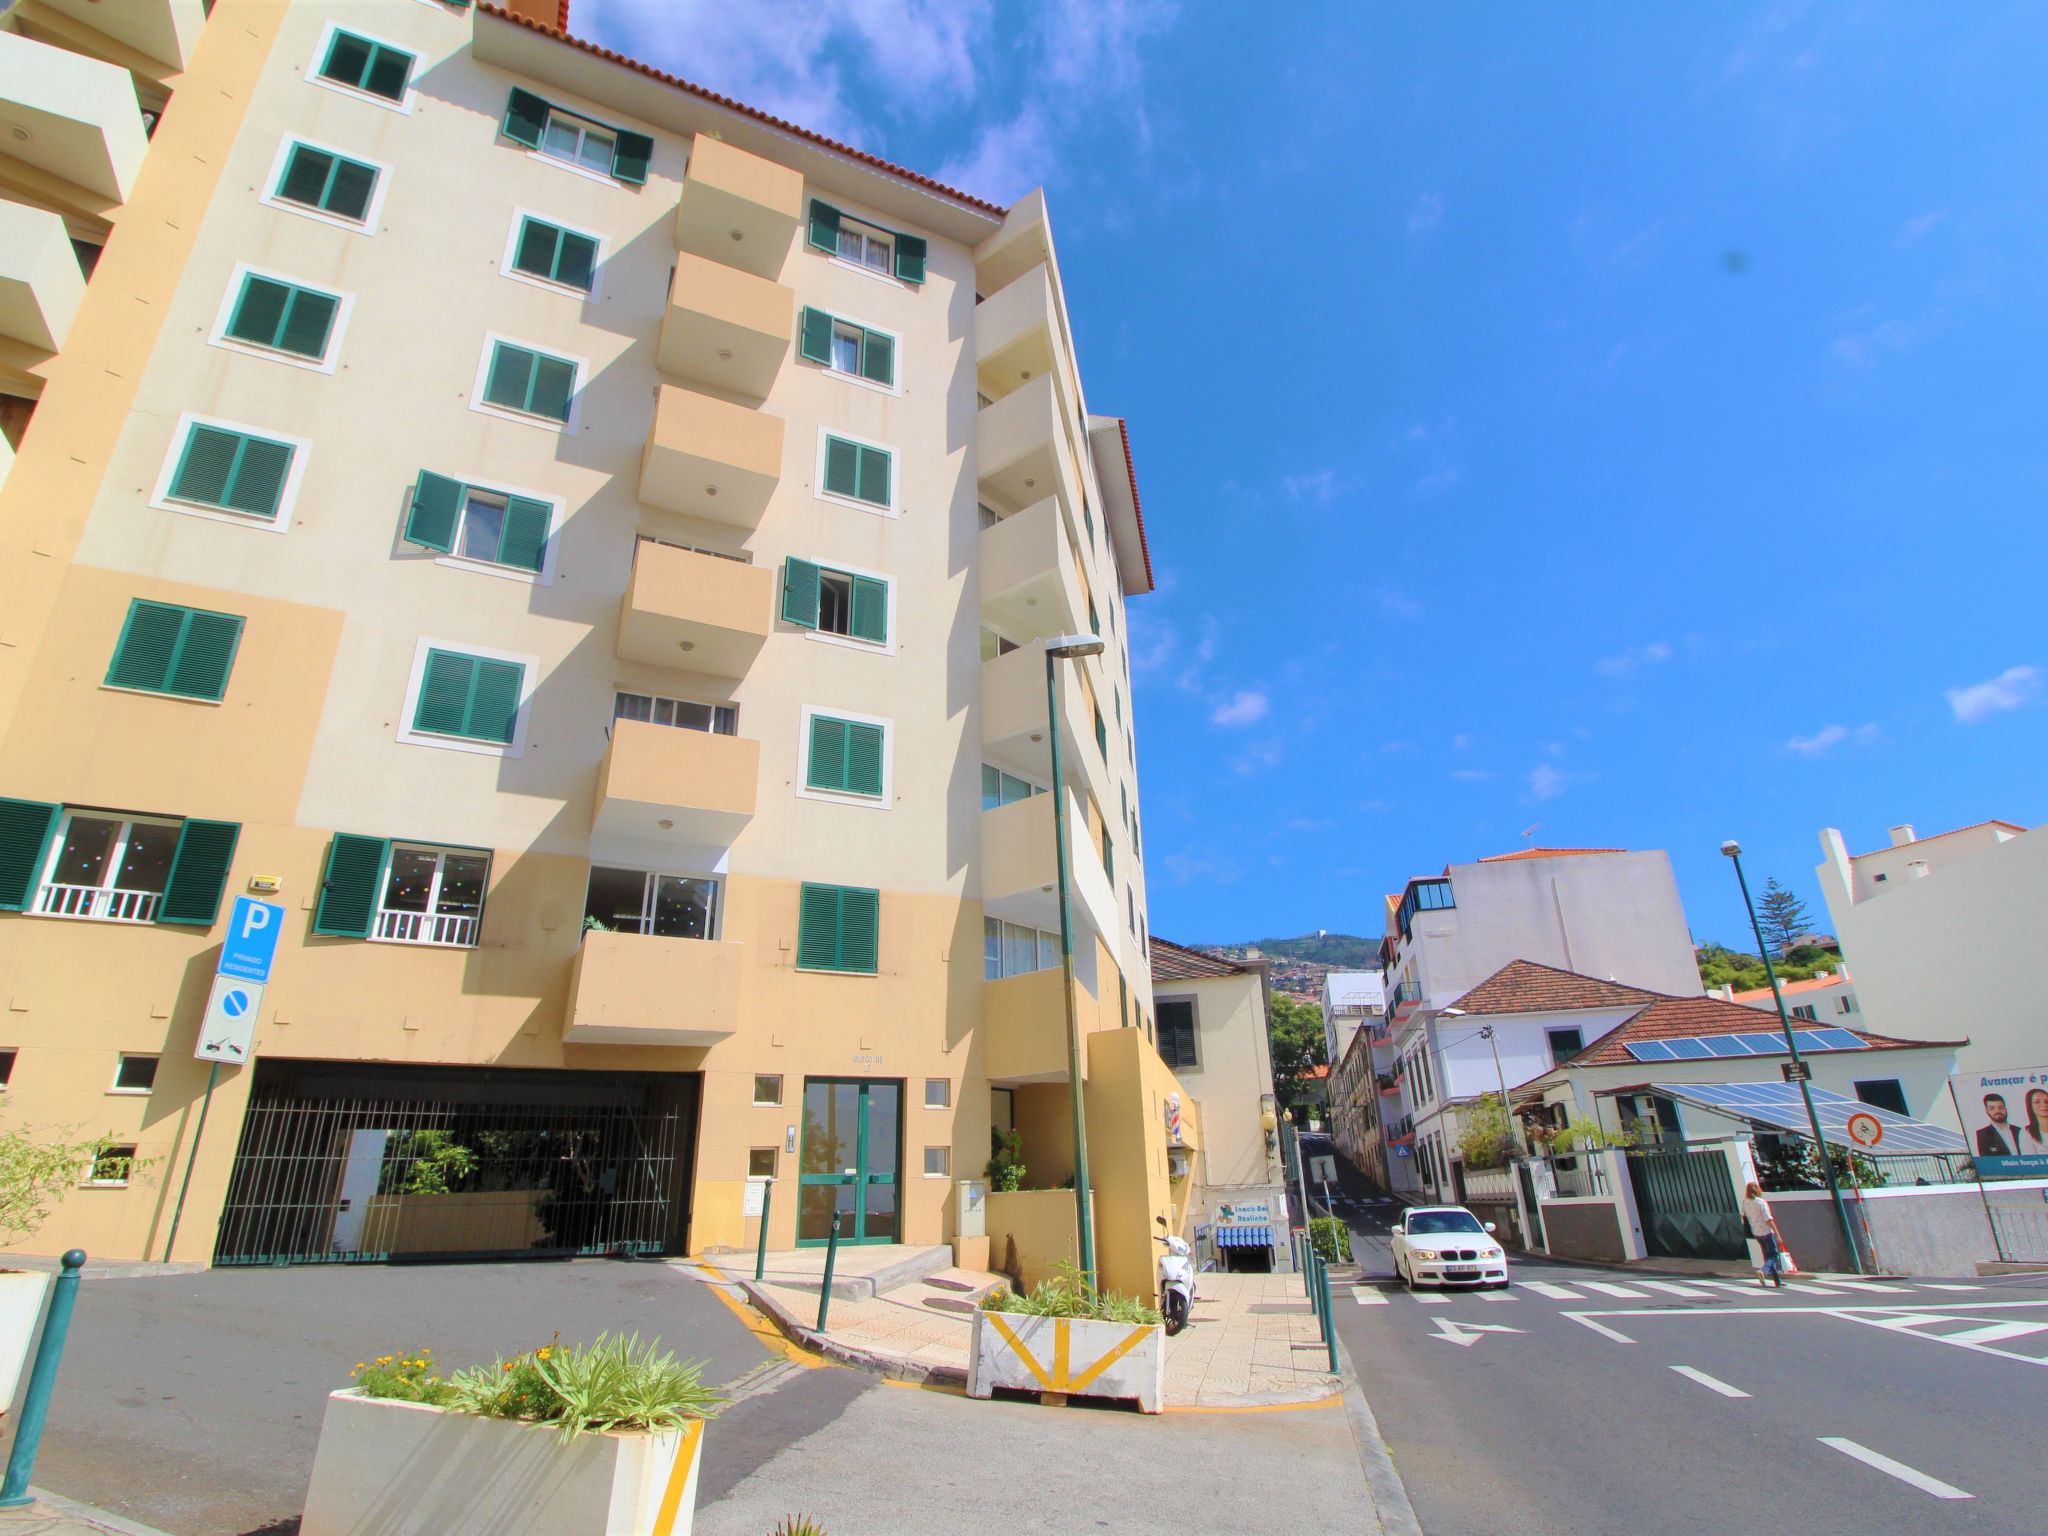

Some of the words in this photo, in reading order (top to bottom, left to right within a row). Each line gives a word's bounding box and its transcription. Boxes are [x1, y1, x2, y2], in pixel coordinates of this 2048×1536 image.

[242, 903, 270, 938] P
[233, 952, 262, 965] PRIVADO
[224, 962, 266, 976] RESIDENTES
[1980, 1076, 2025, 1087] Avançar
[2029, 1072, 2037, 1083] é
